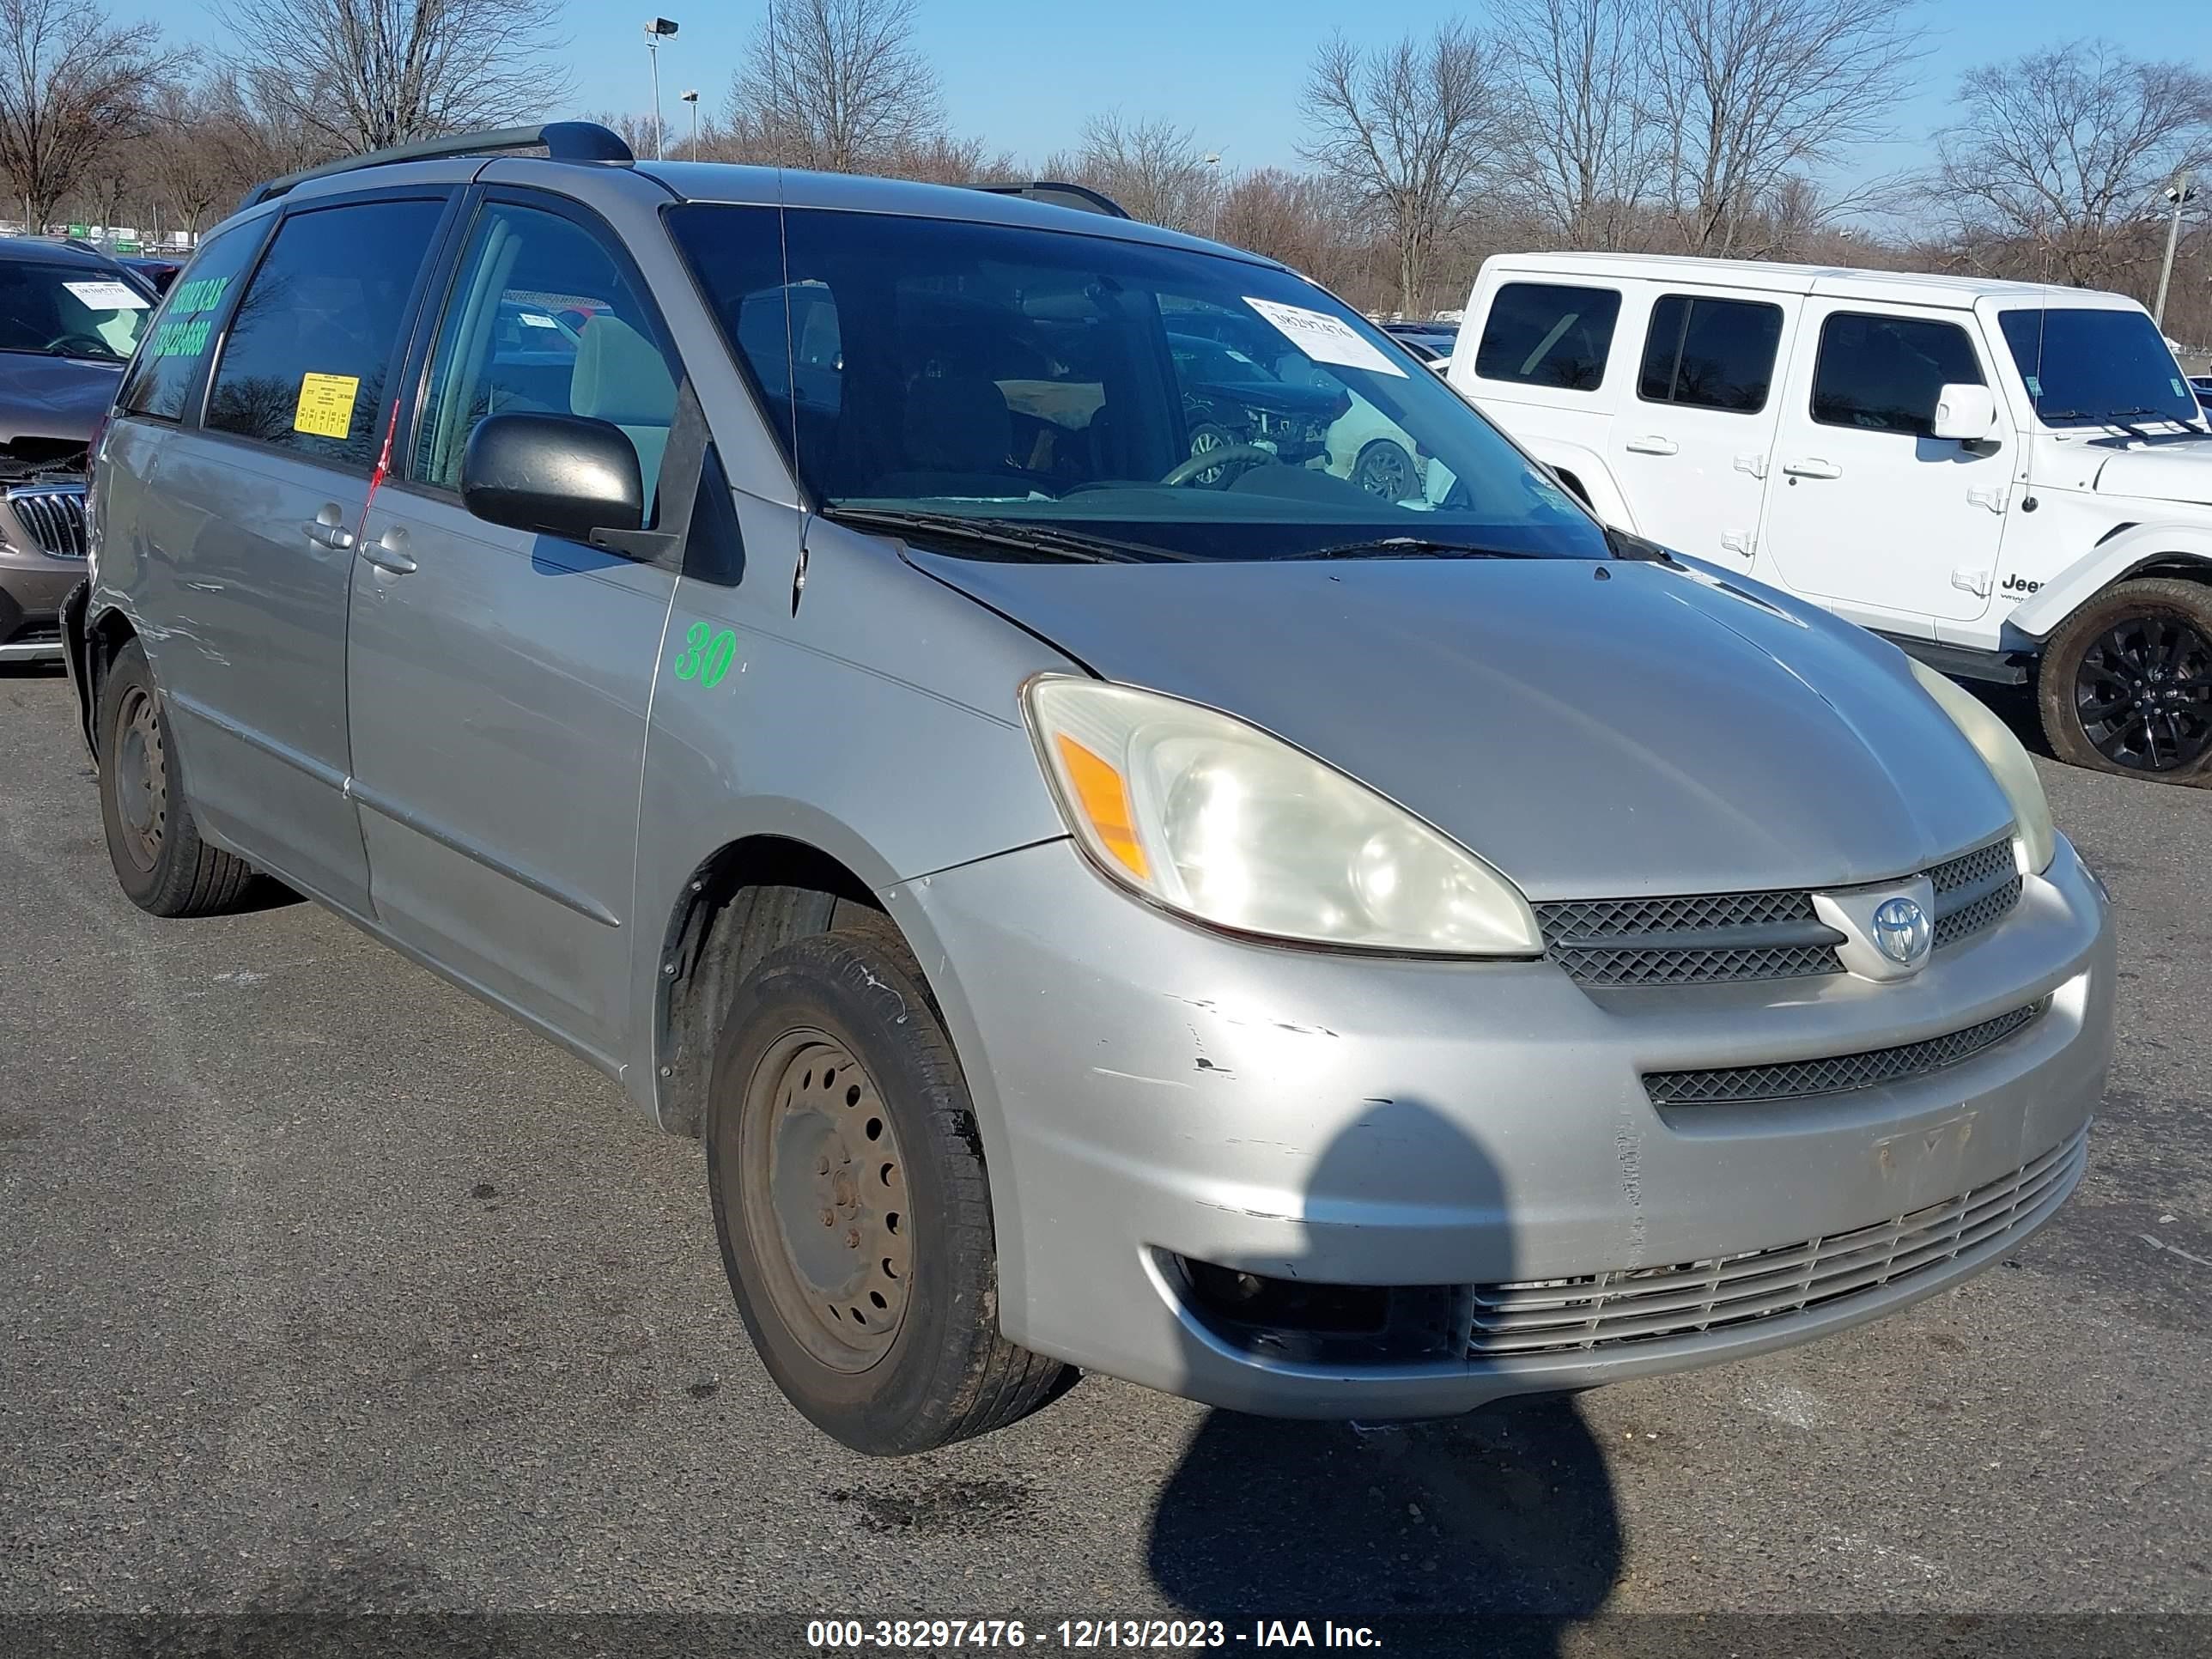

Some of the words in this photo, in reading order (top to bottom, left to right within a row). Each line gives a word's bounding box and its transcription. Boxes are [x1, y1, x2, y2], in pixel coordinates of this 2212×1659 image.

[198, 277, 228, 312] CAB
[1270, 313, 1354, 339] 38297476
[675, 622, 737, 688] 30
